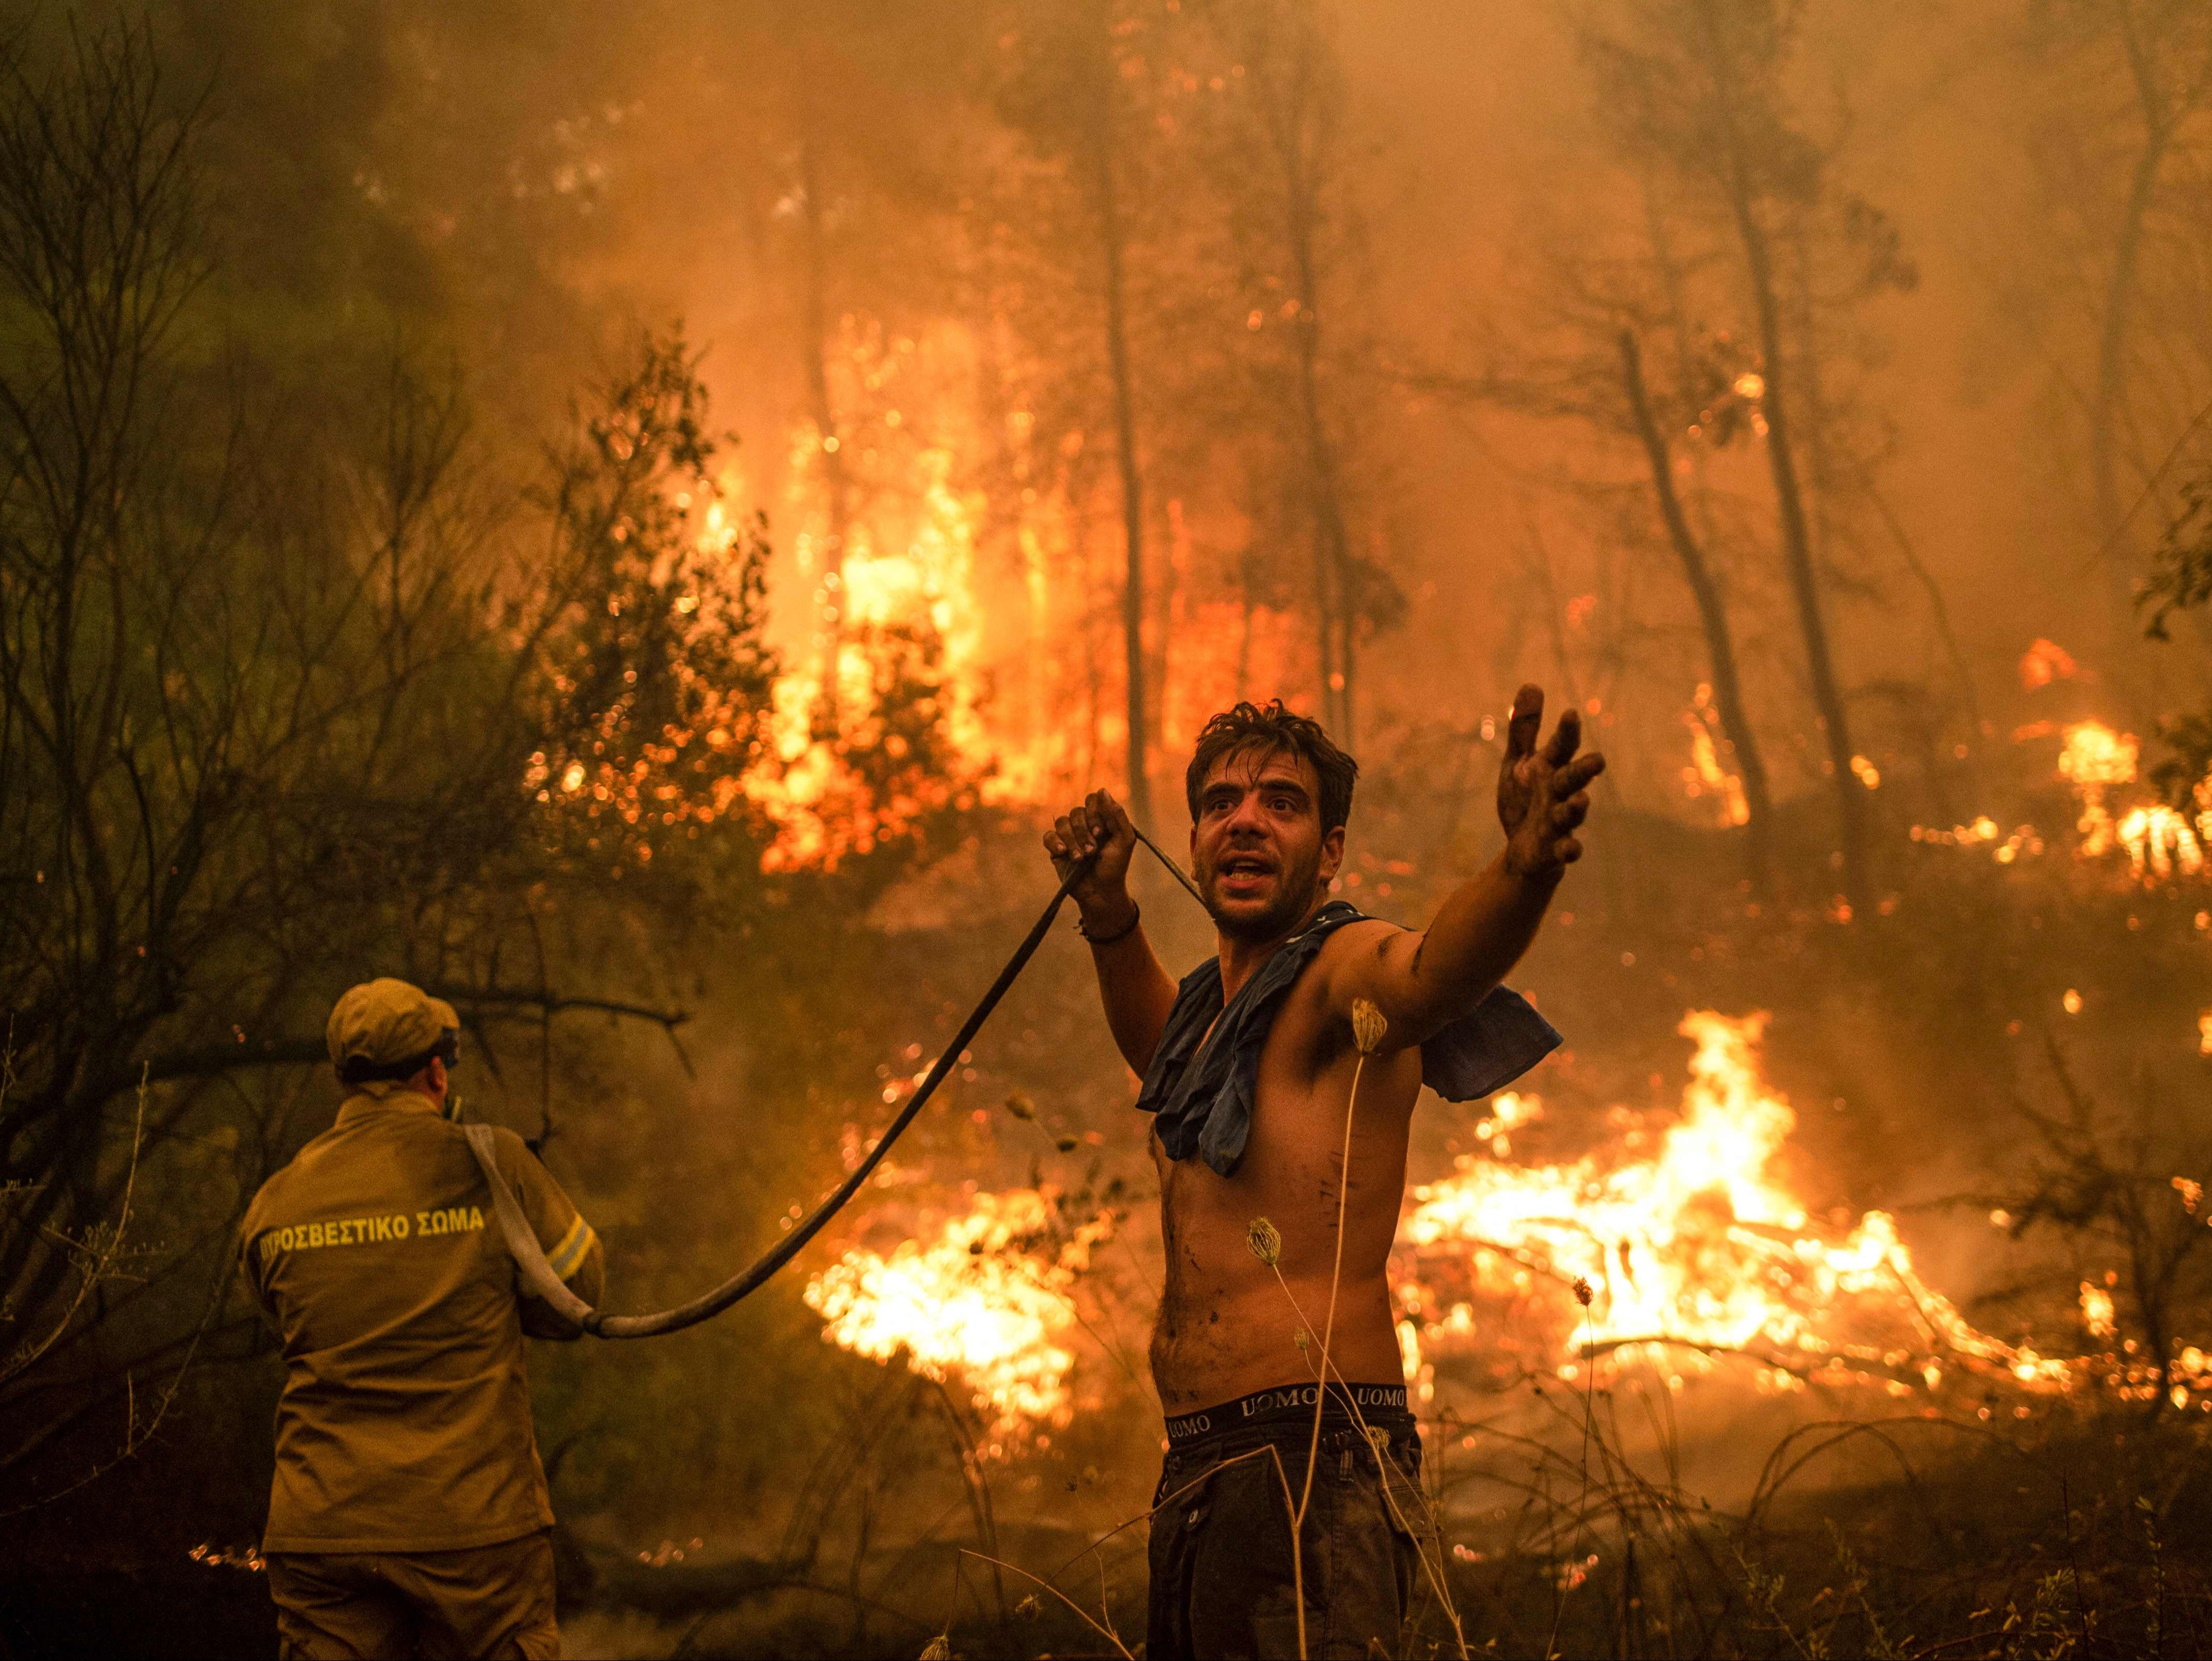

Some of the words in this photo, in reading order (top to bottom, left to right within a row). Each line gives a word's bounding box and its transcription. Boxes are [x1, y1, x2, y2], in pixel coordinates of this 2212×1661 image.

[417, 1206, 485, 1236] ΣΩΜΑ
[1169, 1415, 1210, 1438] UOMO
[1242, 1387, 1319, 1416] UOMO
[1358, 1387, 1405, 1406] UOMO
